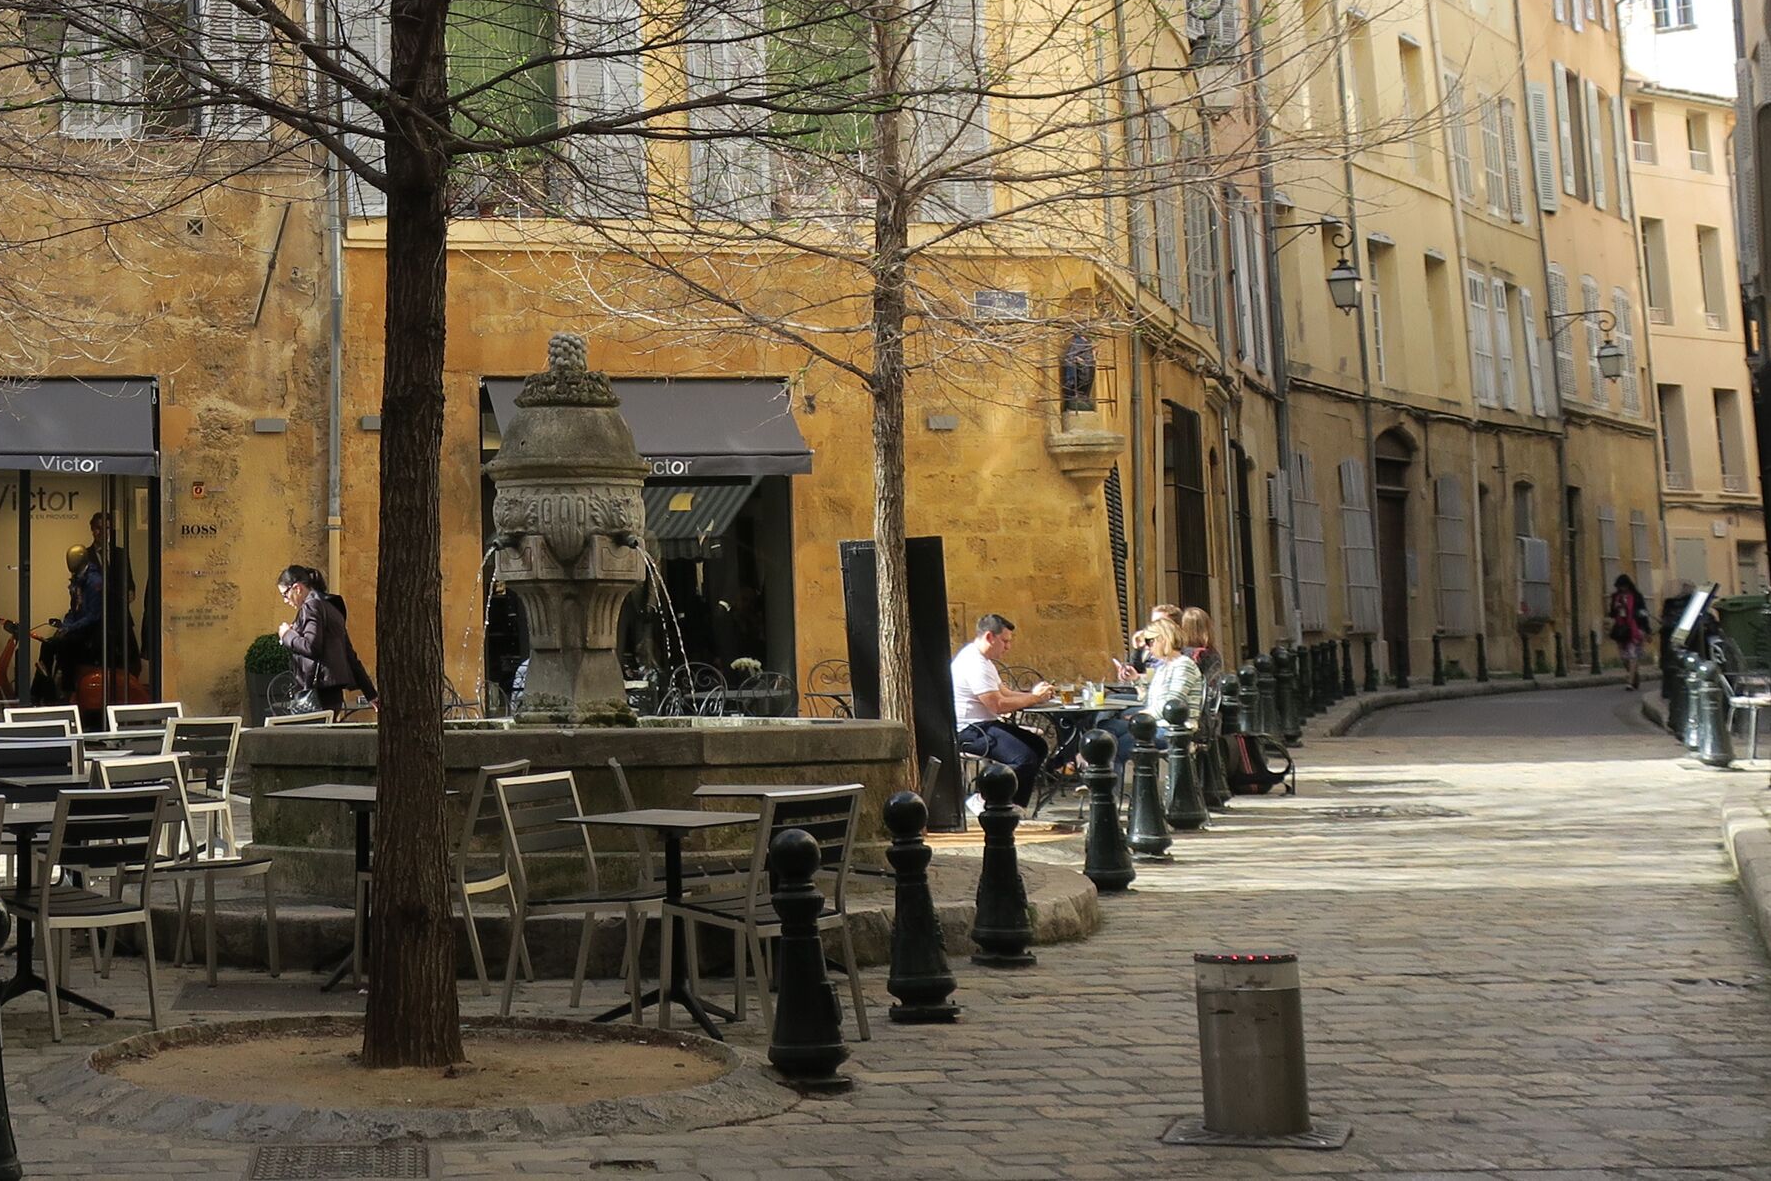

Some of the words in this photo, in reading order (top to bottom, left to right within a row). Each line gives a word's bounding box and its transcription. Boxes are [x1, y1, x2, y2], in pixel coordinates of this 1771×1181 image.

[39, 455, 103, 472] Victor
[642, 457, 692, 475] ictor
[181, 524, 217, 536] BOSS
